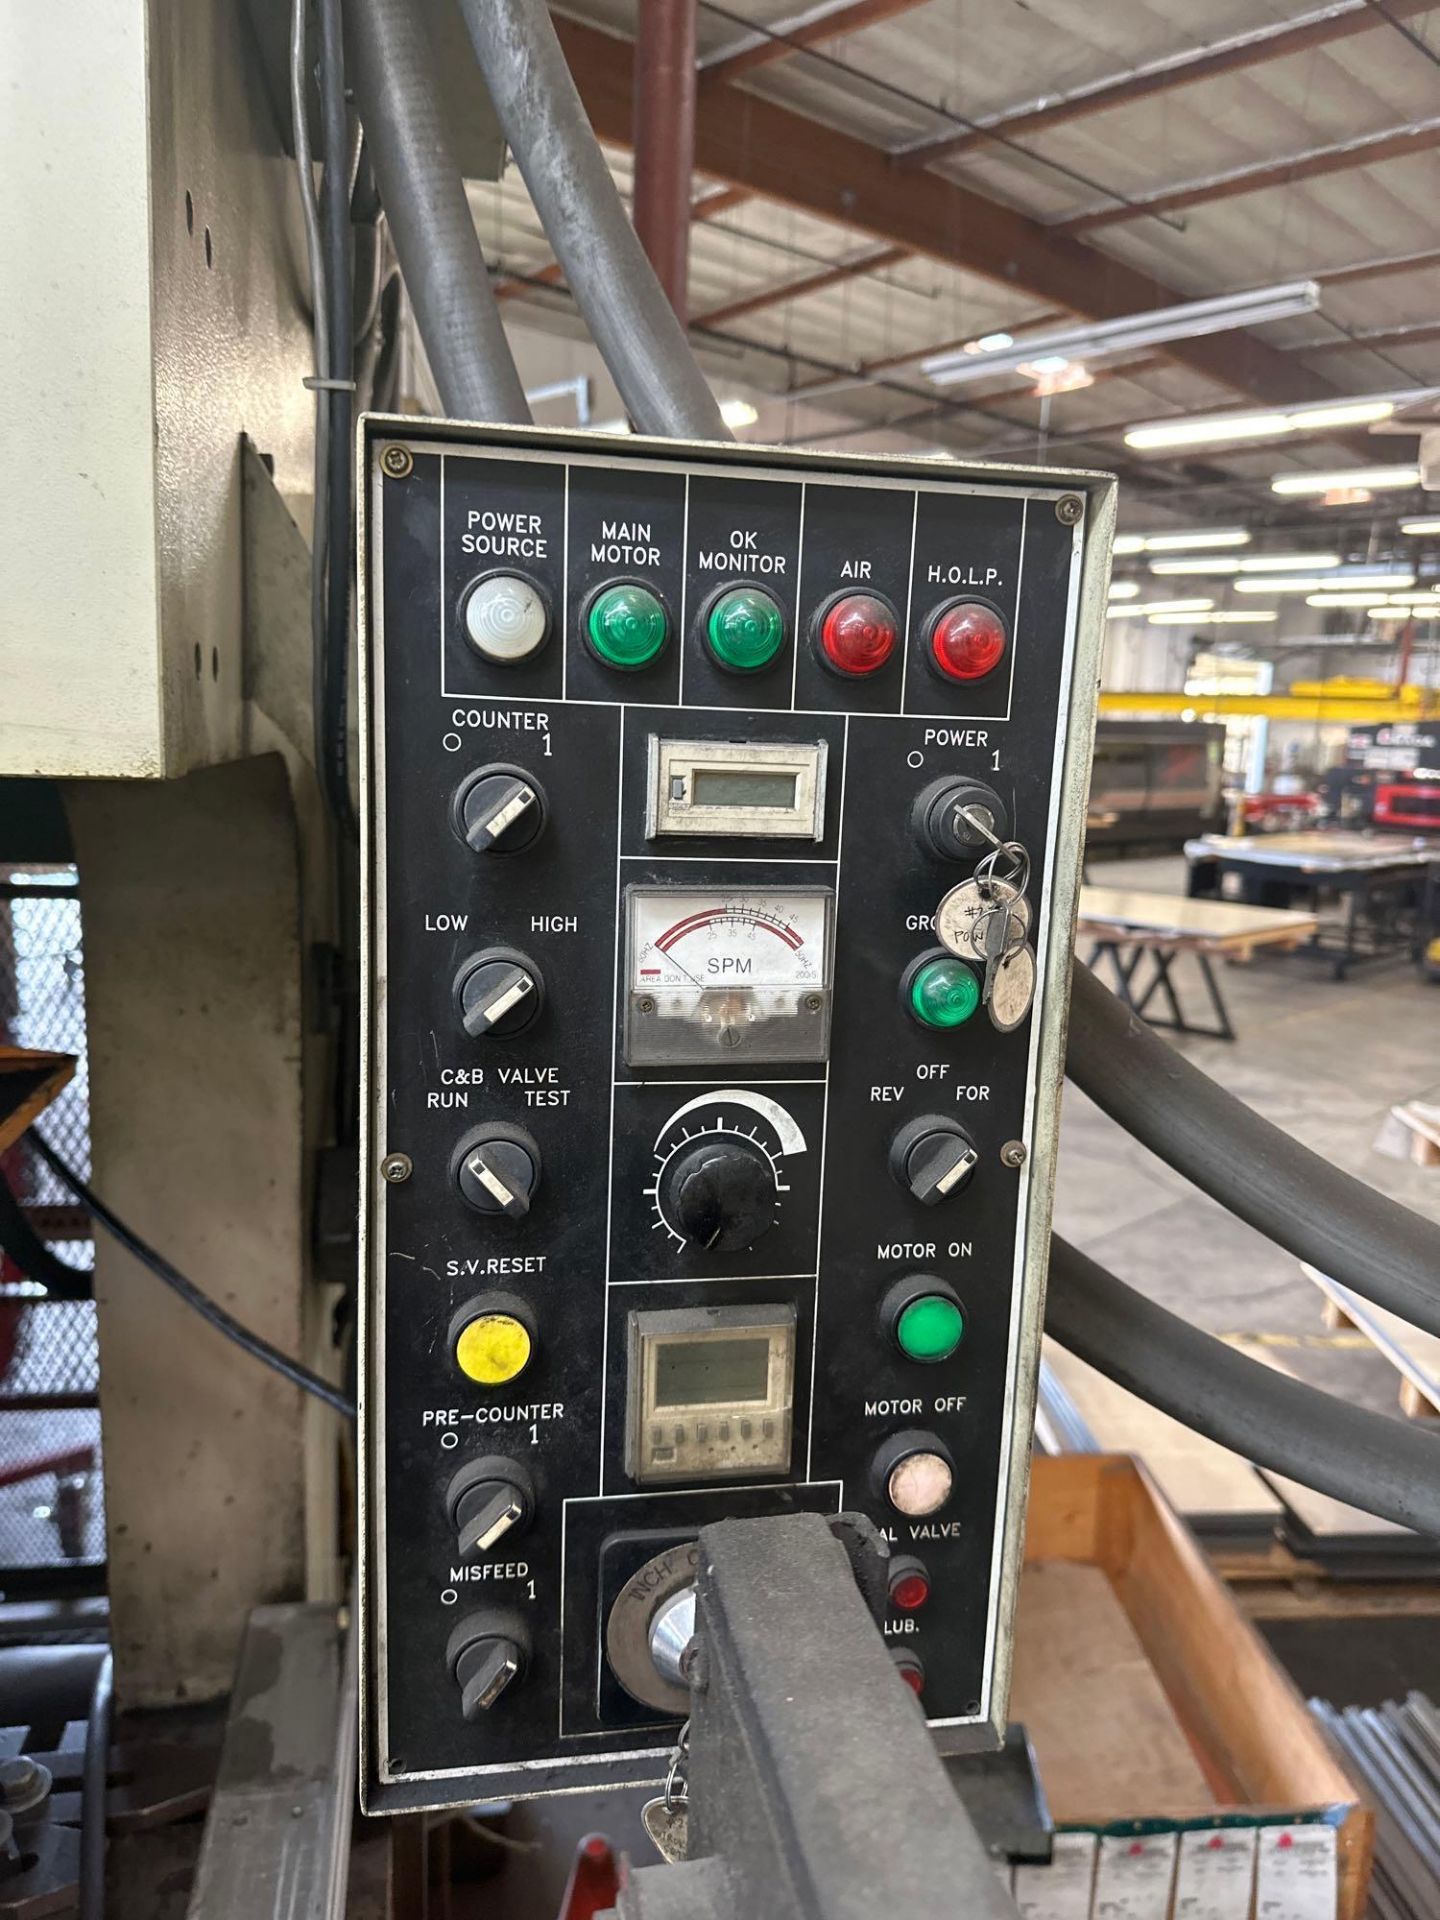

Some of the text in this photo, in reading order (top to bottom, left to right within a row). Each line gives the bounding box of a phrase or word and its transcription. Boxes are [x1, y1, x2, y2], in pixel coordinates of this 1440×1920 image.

[467, 511, 541, 535] POWER
[602, 521, 651, 543] MAIN
[462, 534, 547, 559] SOURCE
[730, 531, 758, 550] OK
[591, 543, 660, 567] MOTOR
[699, 551, 786, 575] MONITOR
[841, 560, 872, 580] AIR
[928, 565, 1003, 587] H.O.L.P.
[451, 709, 550, 731] COUNTER
[541, 733, 553, 757] 1
[924, 729, 988, 750] POWER
[991, 750, 1001, 772] 1
[425, 914, 469, 932] LOW
[531, 916, 578, 933] HIGH
[707, 957, 752, 974] SPM
[441, 1067, 559, 1085] C&B VALVE
[916, 1064, 950, 1080] OFF
[427, 1092, 468, 1109] RUN
[524, 1090, 571, 1107] TEST
[870, 1087, 905, 1102] REV
[956, 1086, 990, 1101] FOR
[877, 1242, 973, 1260] MOTOR ON
[422, 1403, 564, 1427] PRE-COUNTER
[864, 1396, 967, 1416] MOTOR OFF
[529, 1423, 540, 1445] 1
[909, 1523, 961, 1539] VALVE
[450, 1563, 529, 1583] MISFEED
[526, 1579, 537, 1600] 1
[884, 1619, 920, 1635] LUB.
